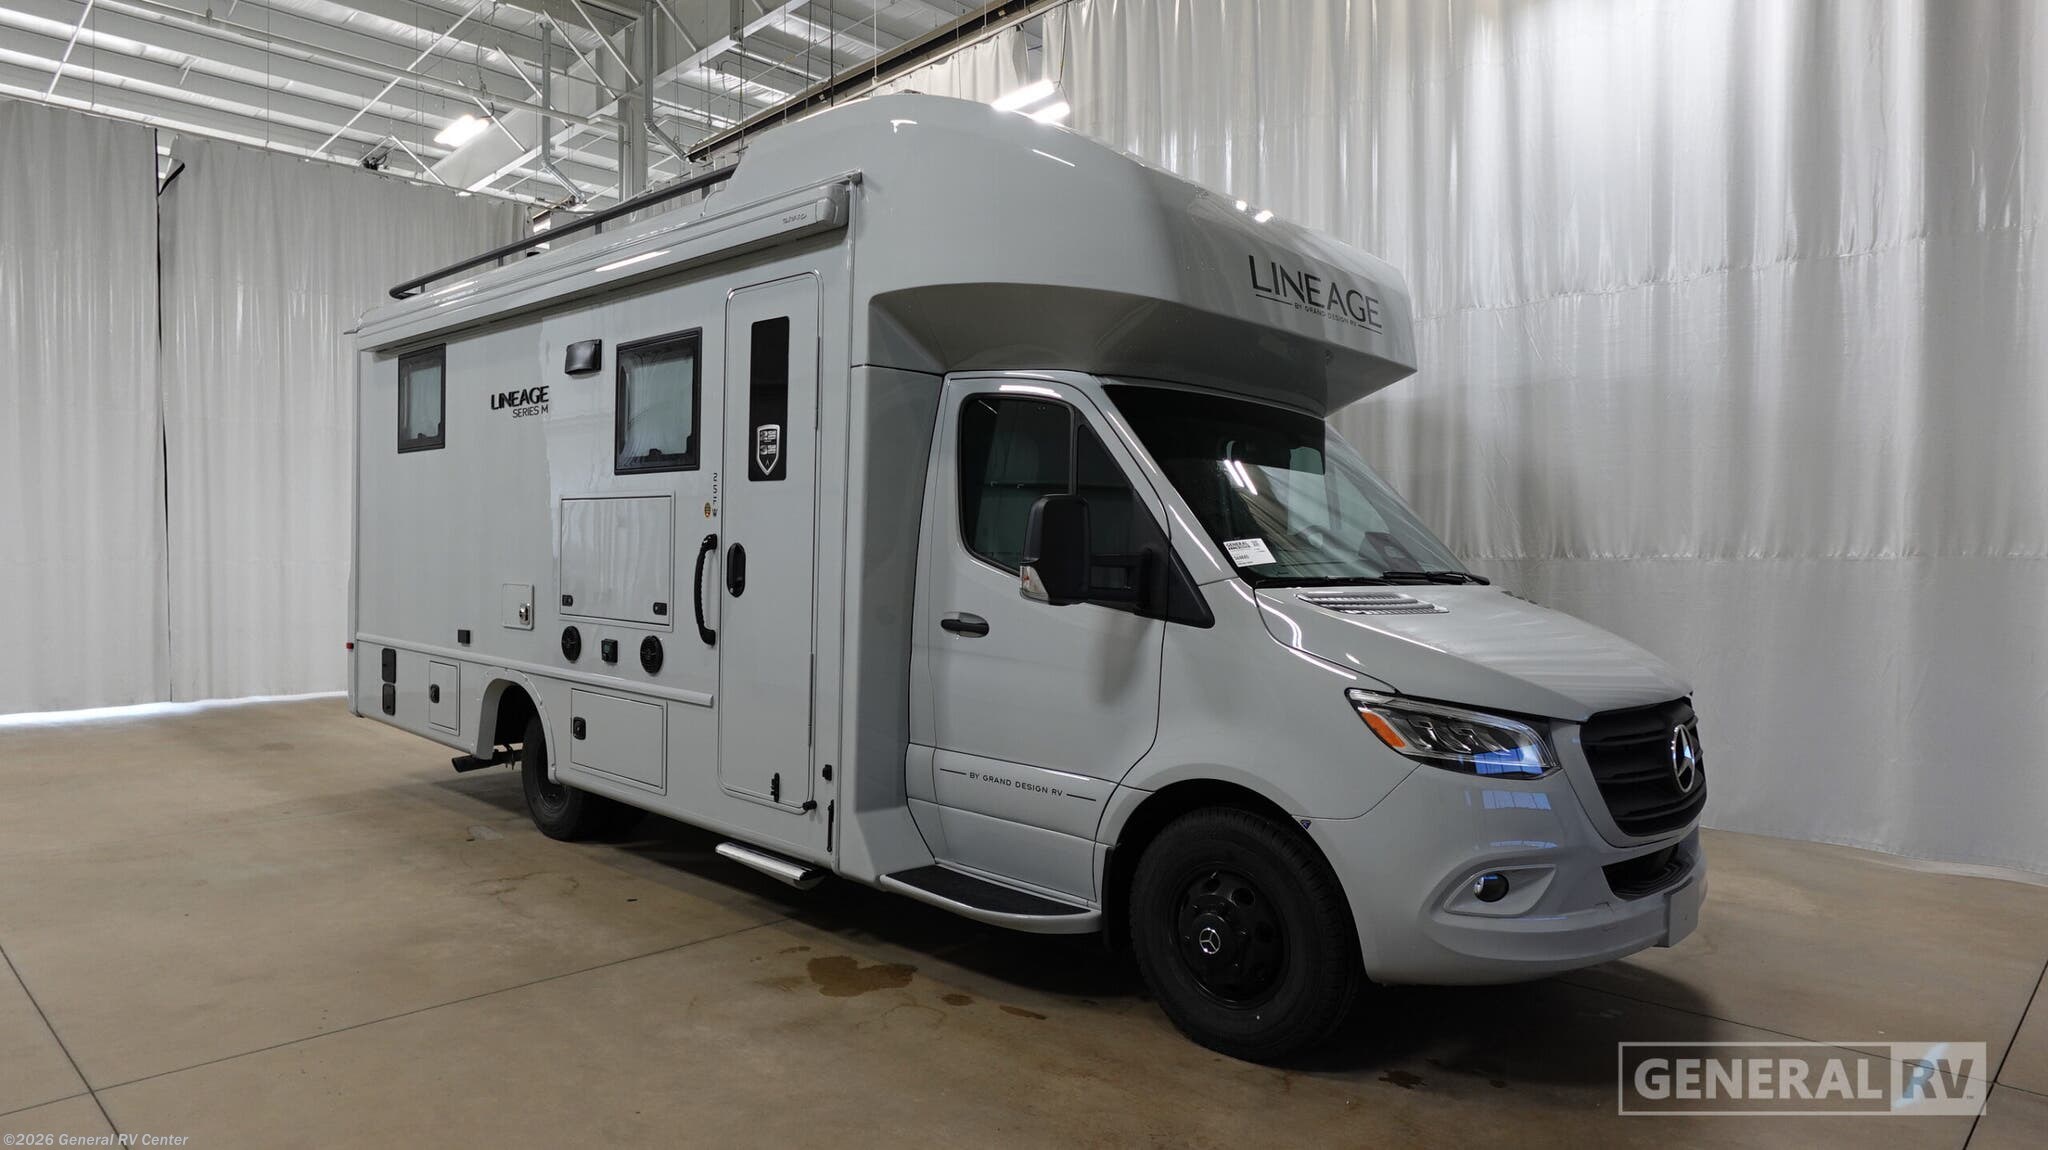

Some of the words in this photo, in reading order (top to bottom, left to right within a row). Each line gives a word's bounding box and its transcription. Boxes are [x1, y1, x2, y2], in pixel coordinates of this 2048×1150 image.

[1248, 255, 1382, 328] LINEAGE
[491, 385, 550, 410] LINEAGE
[512, 405, 540, 419] SERIES
[541, 404, 549, 414] M
[969, 771, 980, 780] BY
[982, 774, 1012, 787] GRAND
[1015, 781, 1048, 794] DESIGN
[1051, 788, 1063, 797] RV
